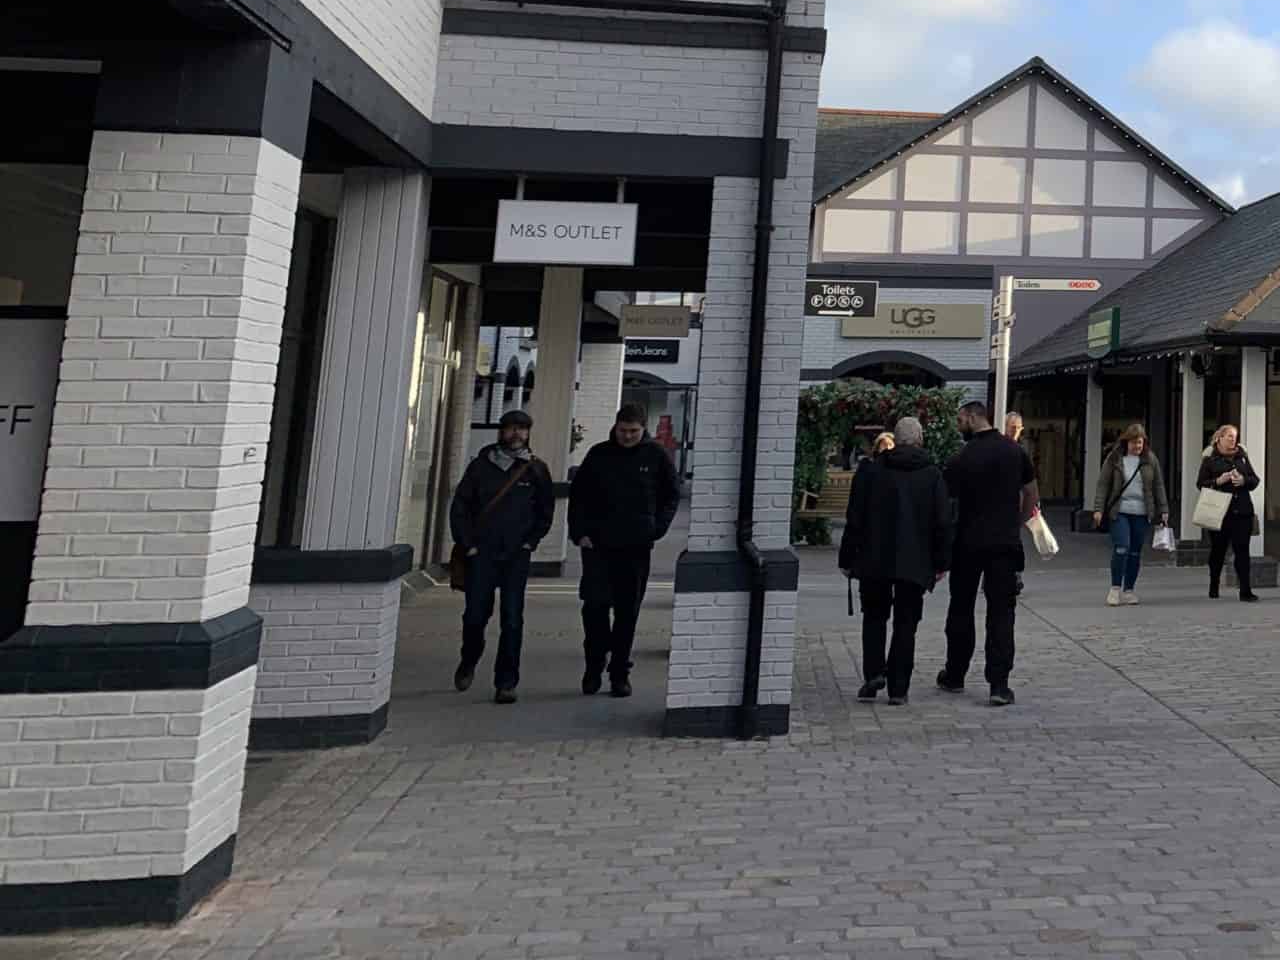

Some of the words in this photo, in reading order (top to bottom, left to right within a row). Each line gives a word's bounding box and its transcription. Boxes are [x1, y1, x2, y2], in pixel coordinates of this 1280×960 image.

[510, 224, 547, 238] M&S
[553, 224, 623, 240] OUTLET
[822, 284, 855, 296] Toilets
[891, 308, 936, 328] UGG
